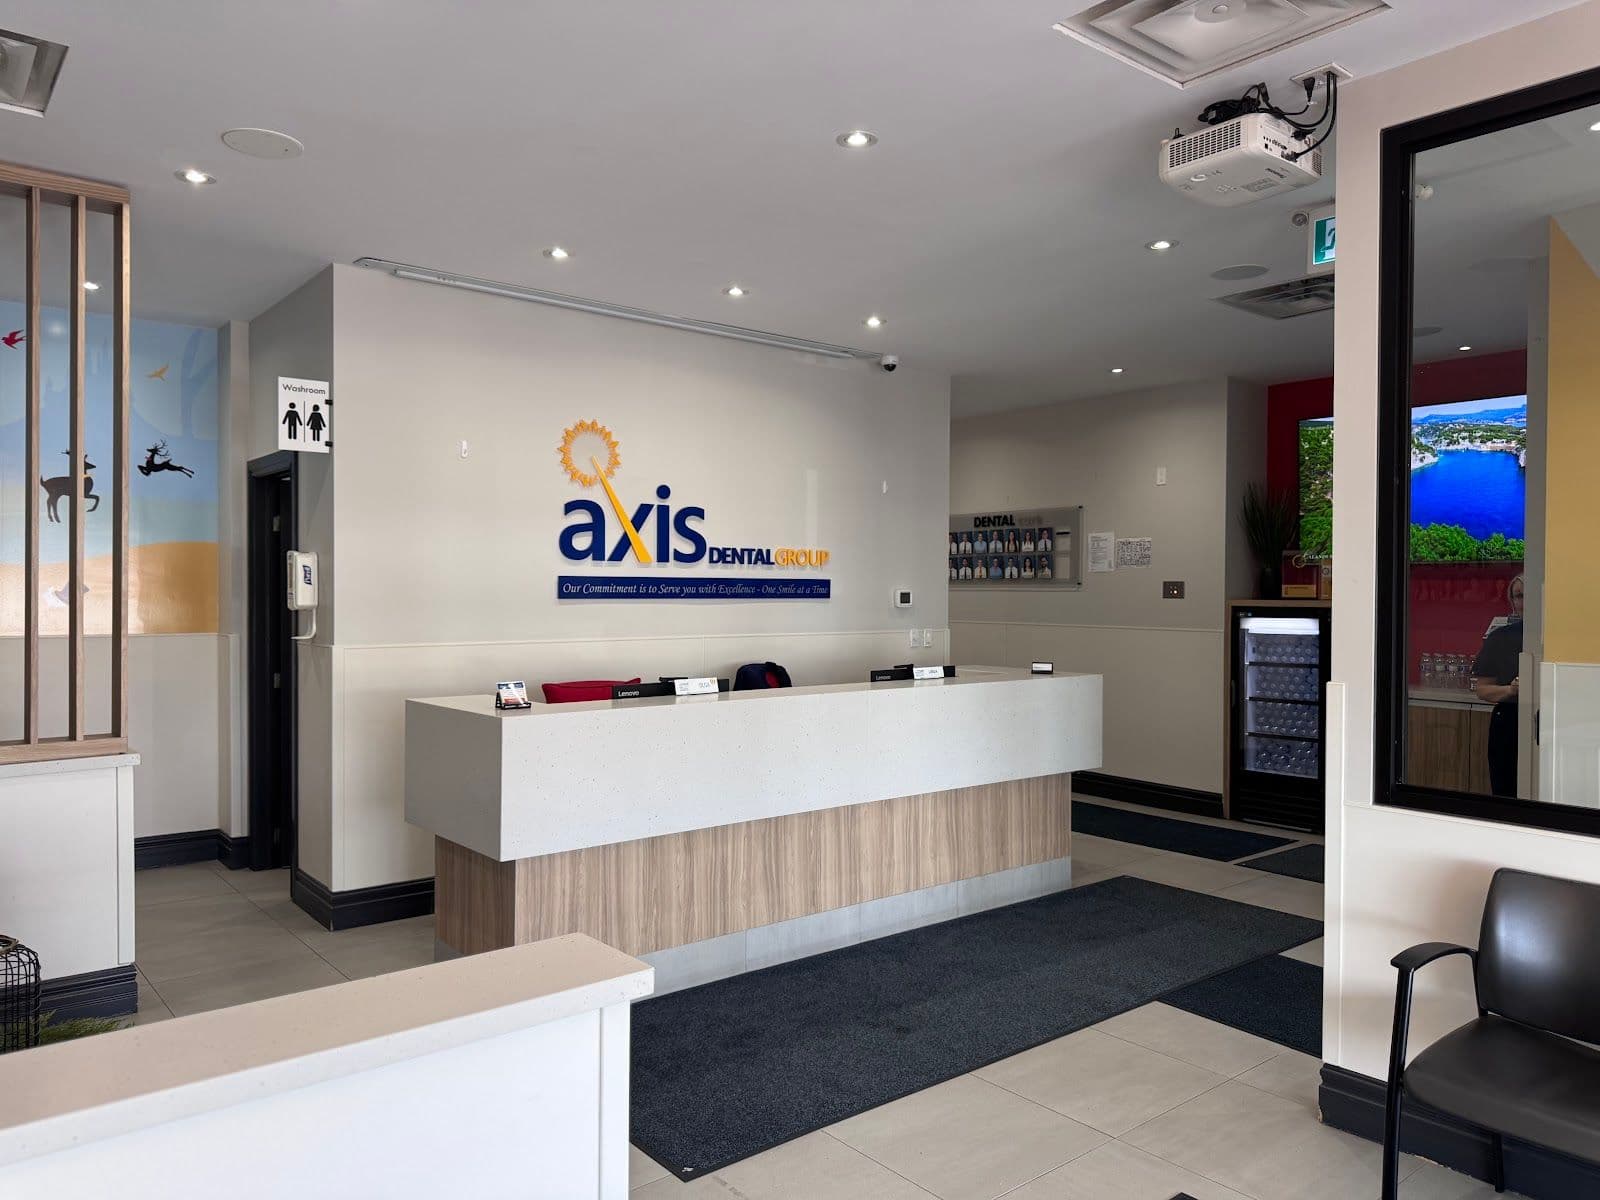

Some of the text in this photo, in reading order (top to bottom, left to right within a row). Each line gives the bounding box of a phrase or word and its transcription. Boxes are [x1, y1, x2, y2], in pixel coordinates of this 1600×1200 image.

[282, 383, 326, 395] Washroom
[558, 484, 830, 567] axis DENTAL GROUP
[973, 514, 1016, 528] DENTAL
[562, 582, 580, 594] Our
[582, 583, 637, 594] Commitment
[639, 583, 647, 594] is
[648, 584, 657, 594] to
[658, 583, 681, 594] Serve
[681, 585, 697, 597] you
[698, 584, 716, 594] with
[717, 584, 756, 595] Excellence
[761, 584, 775, 594] One
[778, 584, 795, 594] Smile
[796, 585, 804, 594] at
[805, 586, 811, 594] a
[811, 584, 828, 594] Time
